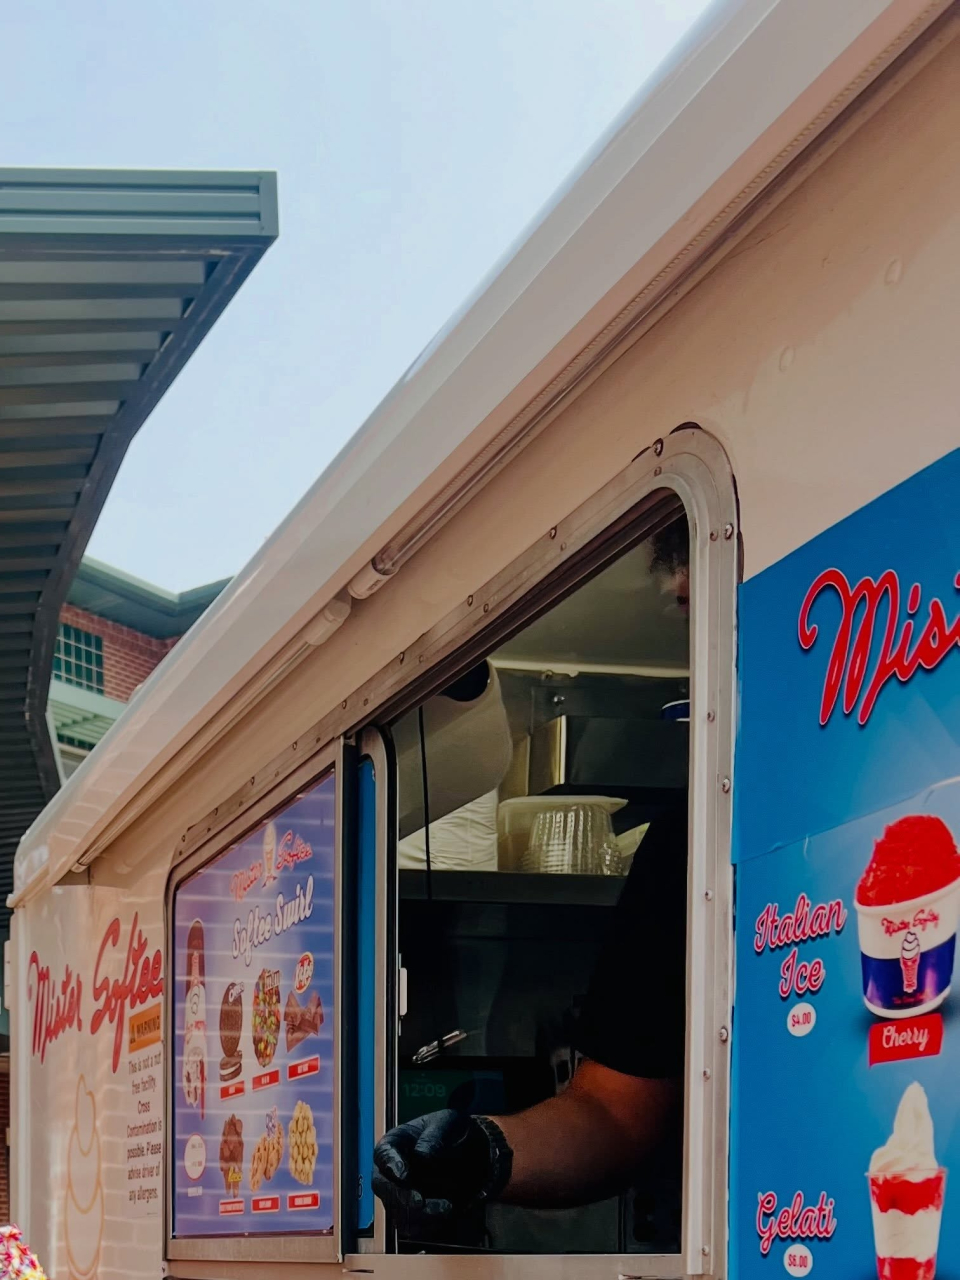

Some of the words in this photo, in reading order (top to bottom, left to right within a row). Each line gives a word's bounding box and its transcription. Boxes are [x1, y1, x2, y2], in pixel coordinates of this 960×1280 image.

[798, 567, 960, 725] Mis
[232, 905, 272, 967] Softee
[274, 873, 314, 936] Swirl
[754, 892, 847, 954] Italian
[27, 950, 82, 1065] Mister
[90, 911, 164, 1074] Softee
[779, 949, 826, 998] Ice
[882, 1026, 930, 1052] Cherry
[756, 1190, 837, 1254] Gelati
